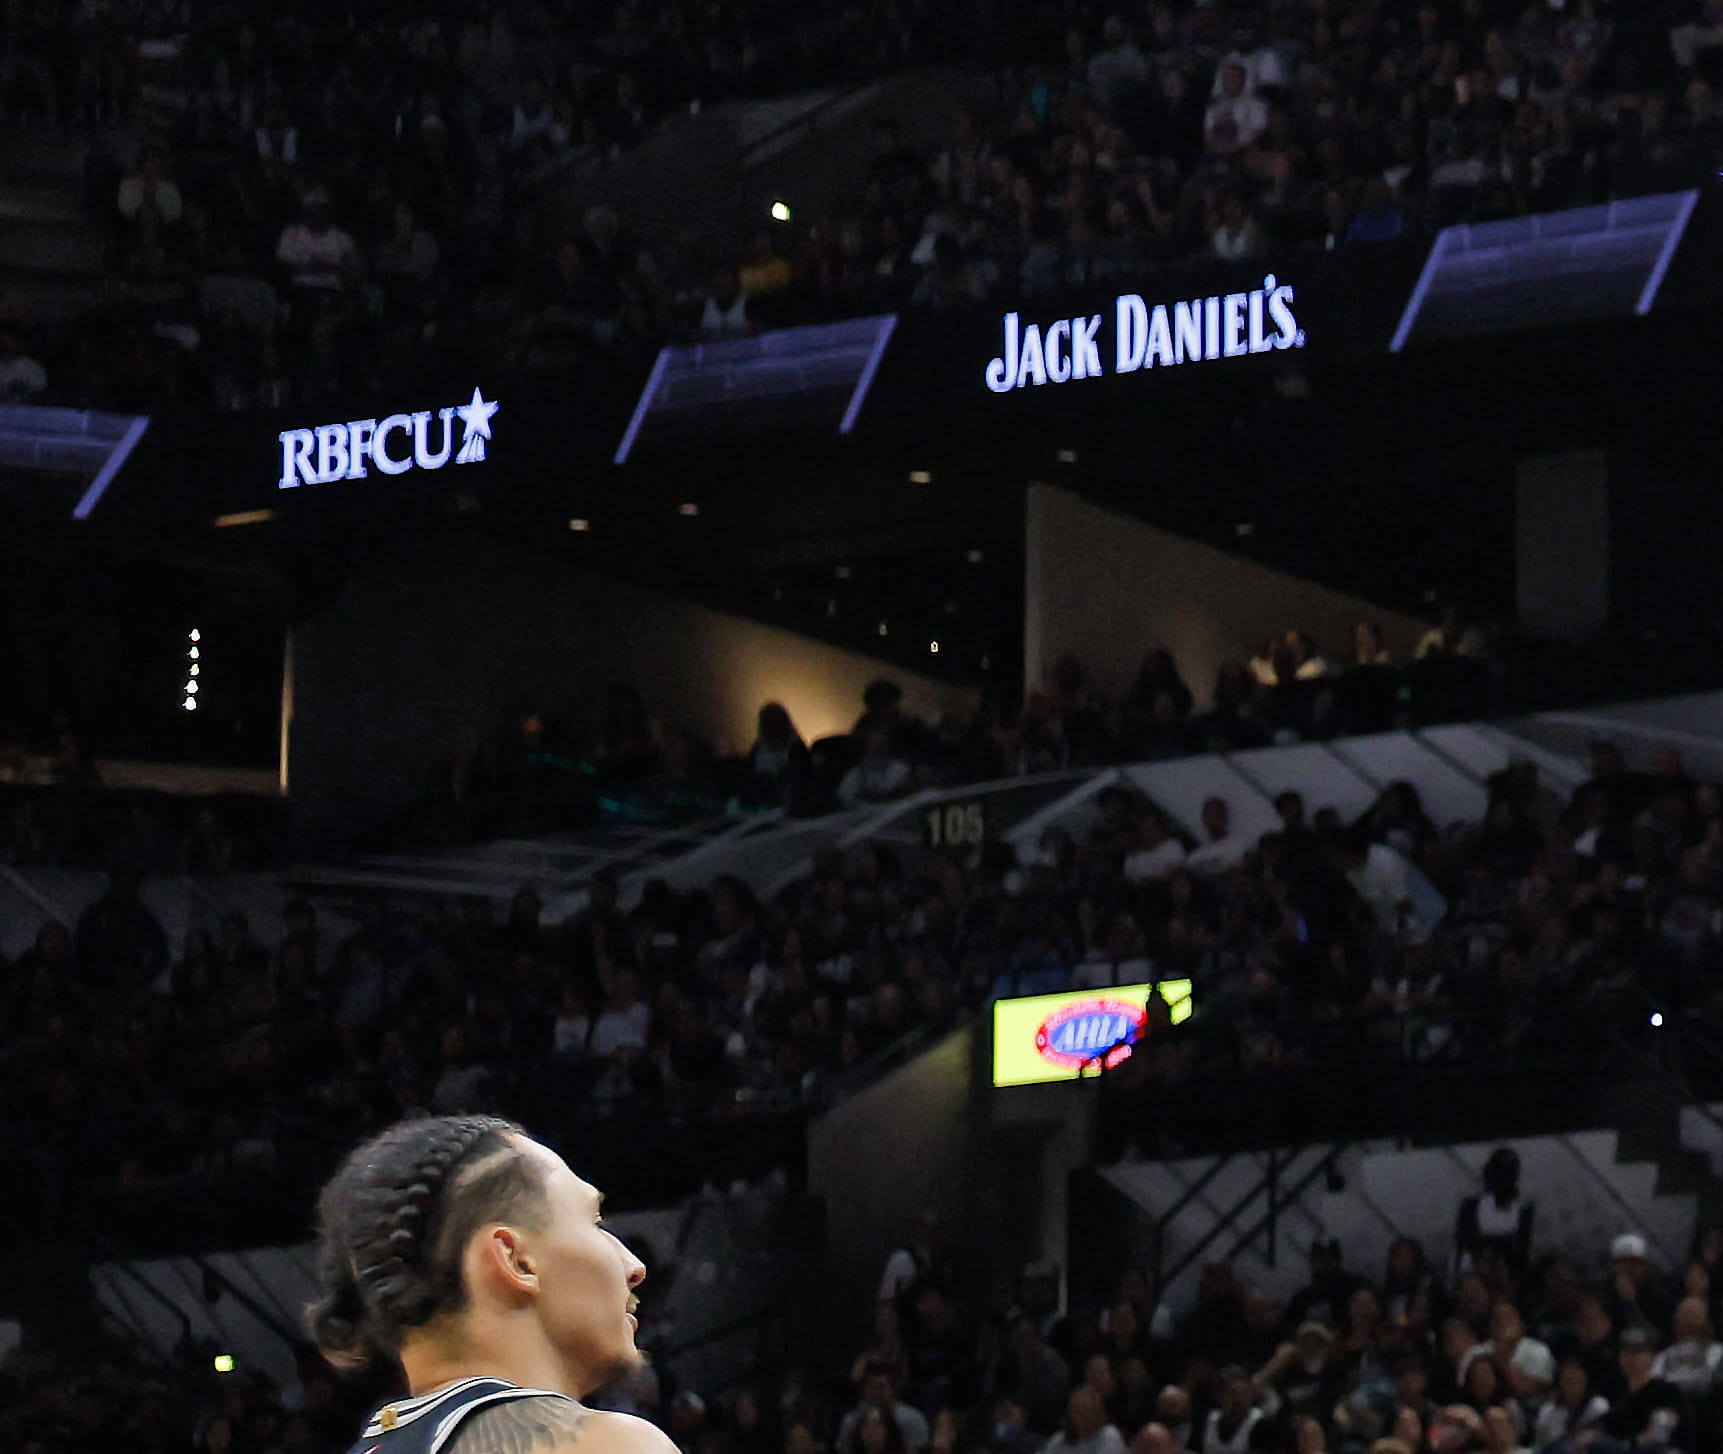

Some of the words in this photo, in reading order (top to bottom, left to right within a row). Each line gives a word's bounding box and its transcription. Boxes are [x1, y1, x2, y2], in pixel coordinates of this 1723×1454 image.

[985, 312, 1103, 392] JACK
[1115, 273, 1298, 374] DANIEL'S
[278, 407, 456, 490] RBFCU
